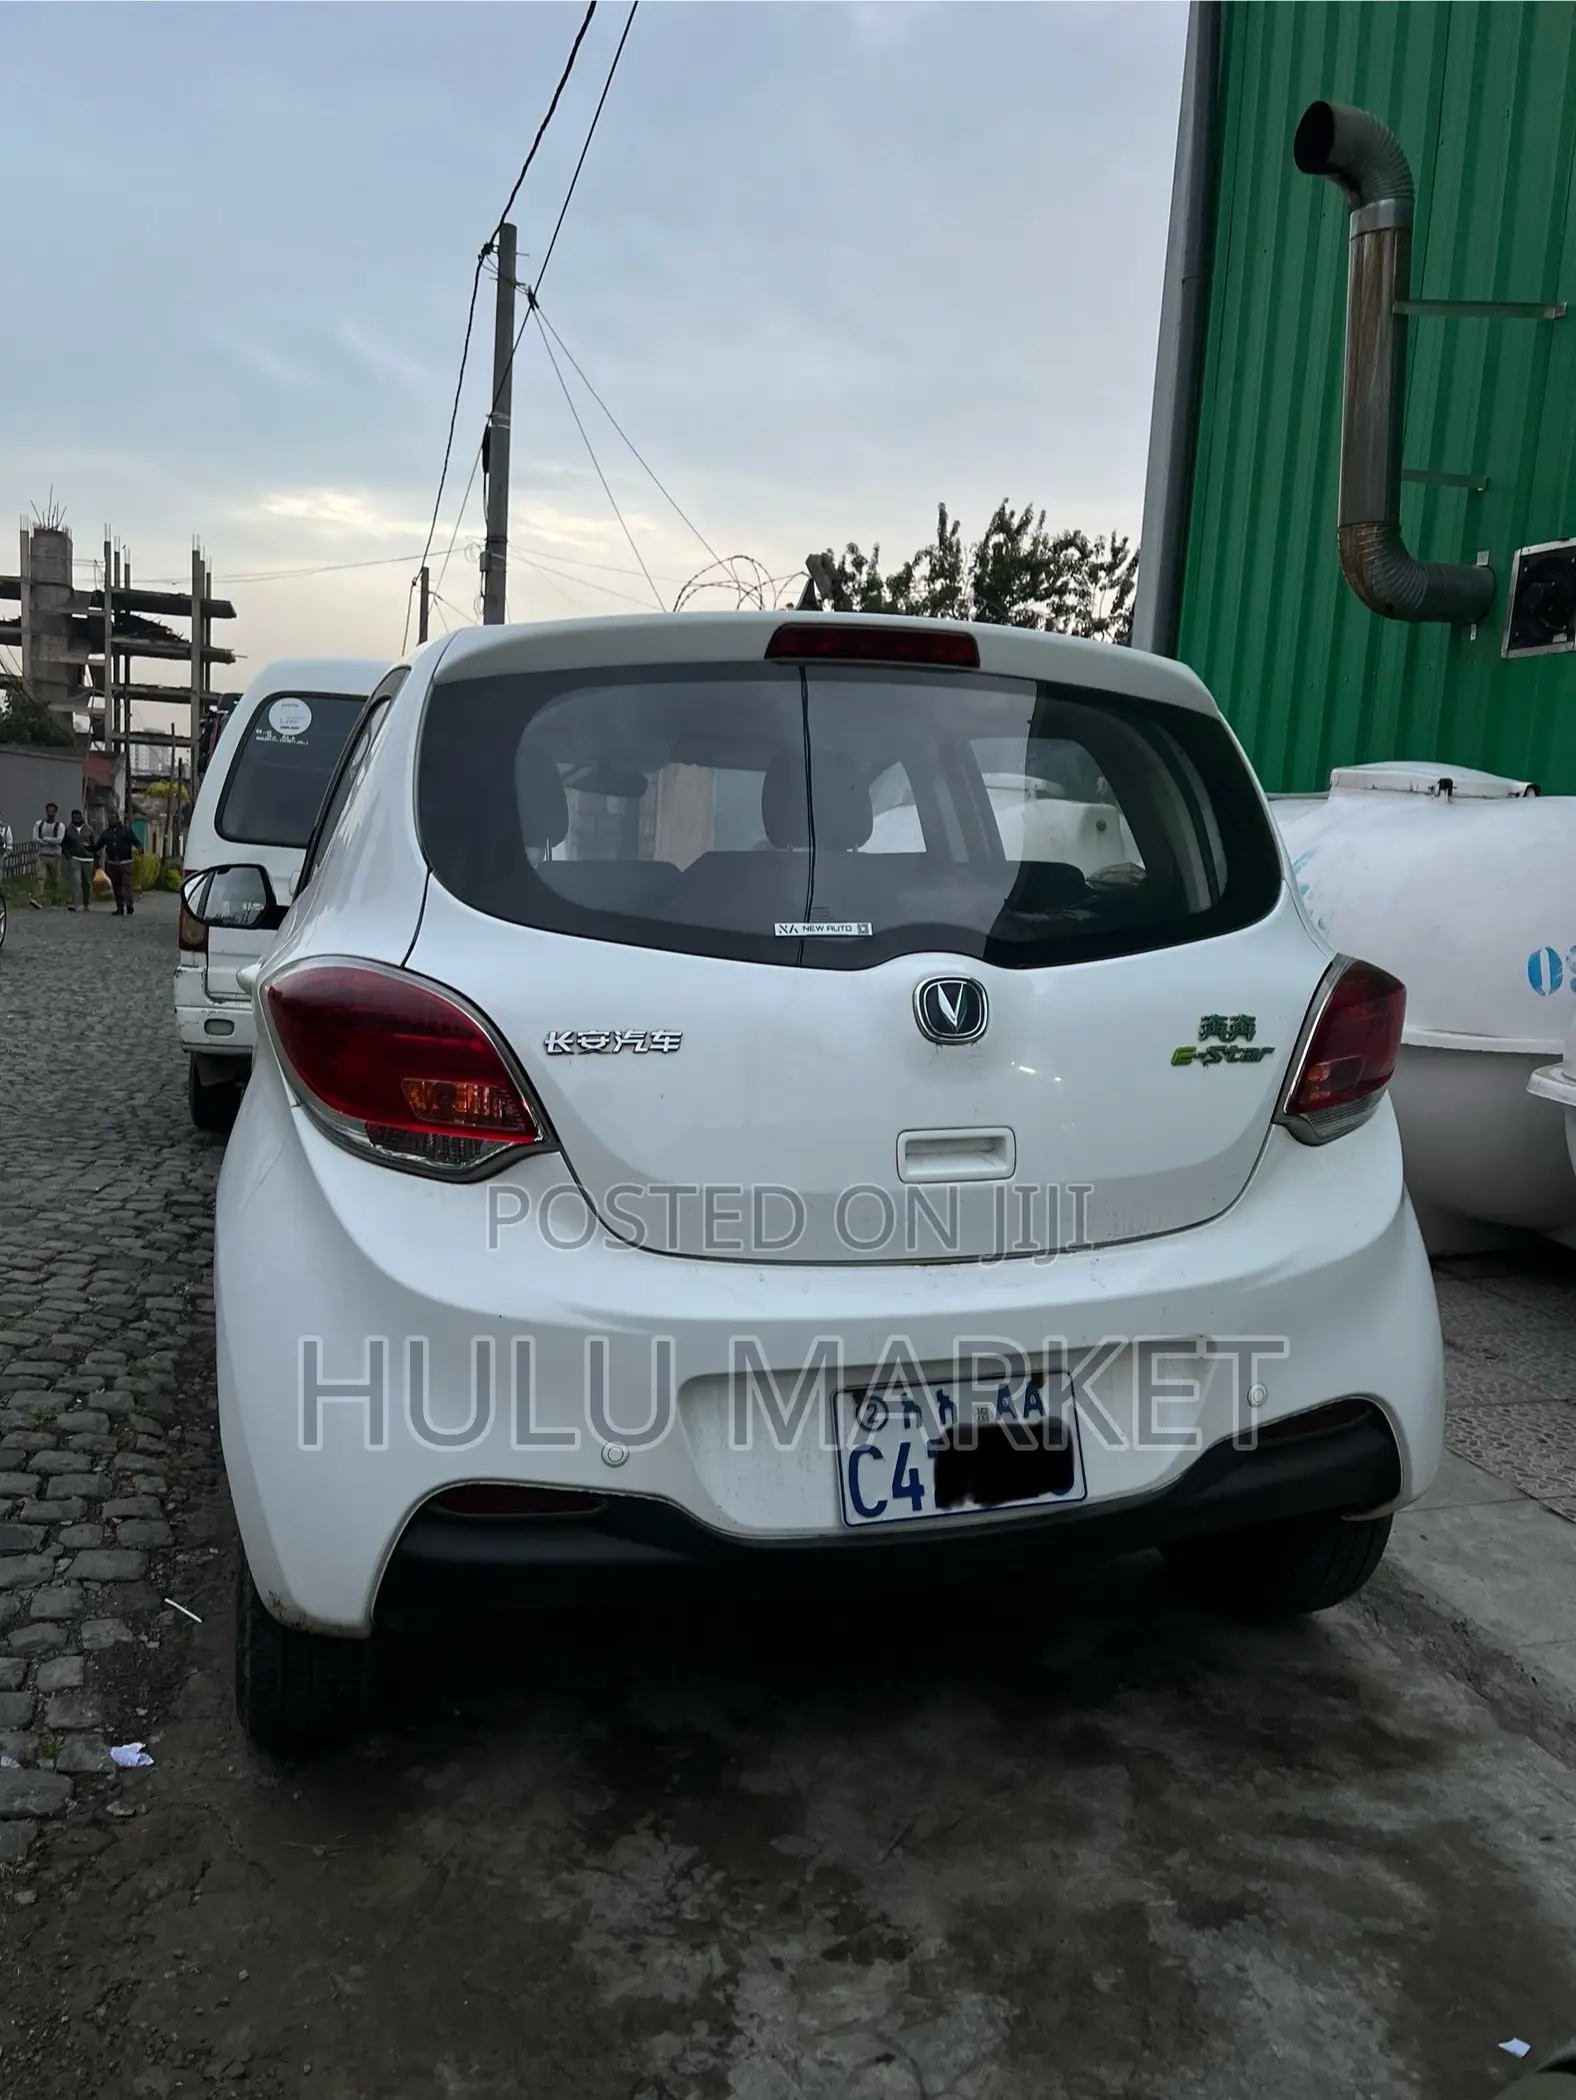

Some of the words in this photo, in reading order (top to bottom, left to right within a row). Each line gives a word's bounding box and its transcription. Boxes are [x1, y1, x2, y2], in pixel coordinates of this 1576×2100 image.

[802, 924, 824, 933] NEW
[826, 924, 853, 933] AUTO
[1527, 945, 1576, 996] 0
[543, 1029, 684, 1055] 长安汽车
